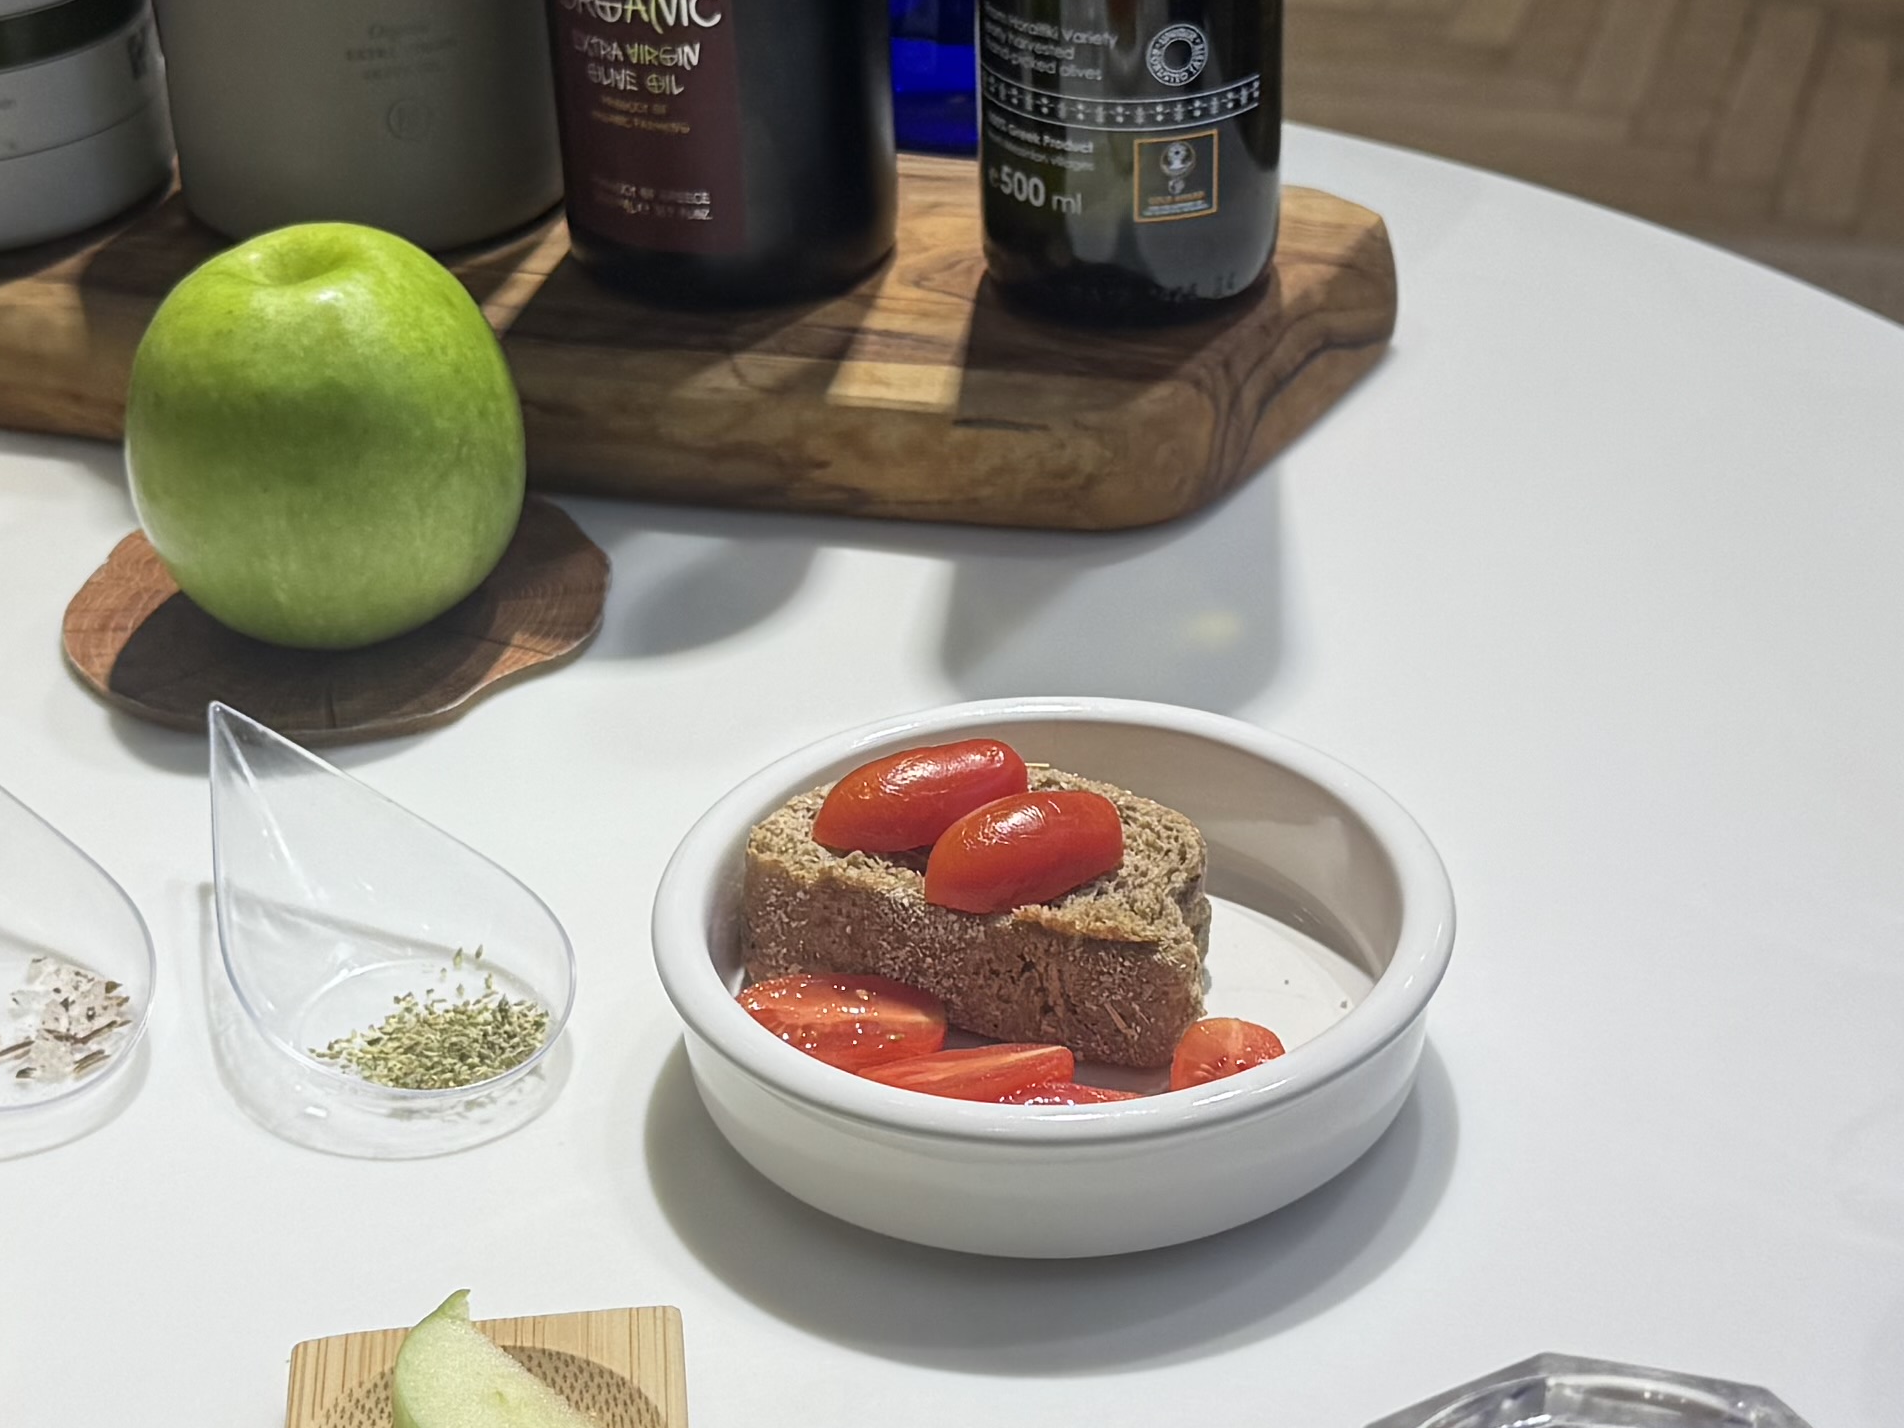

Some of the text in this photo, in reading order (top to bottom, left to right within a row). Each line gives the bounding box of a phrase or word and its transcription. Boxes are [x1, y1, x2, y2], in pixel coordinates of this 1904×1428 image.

[1061, 28, 1119, 51] Variety
[625, 42, 701, 71] VIRGIN
[587, 61, 685, 96] OLIVE OIL
[1059, 64, 1103, 81] olives
[1042, 134, 1094, 154] Product
[999, 164, 1083, 216] 500 ml
